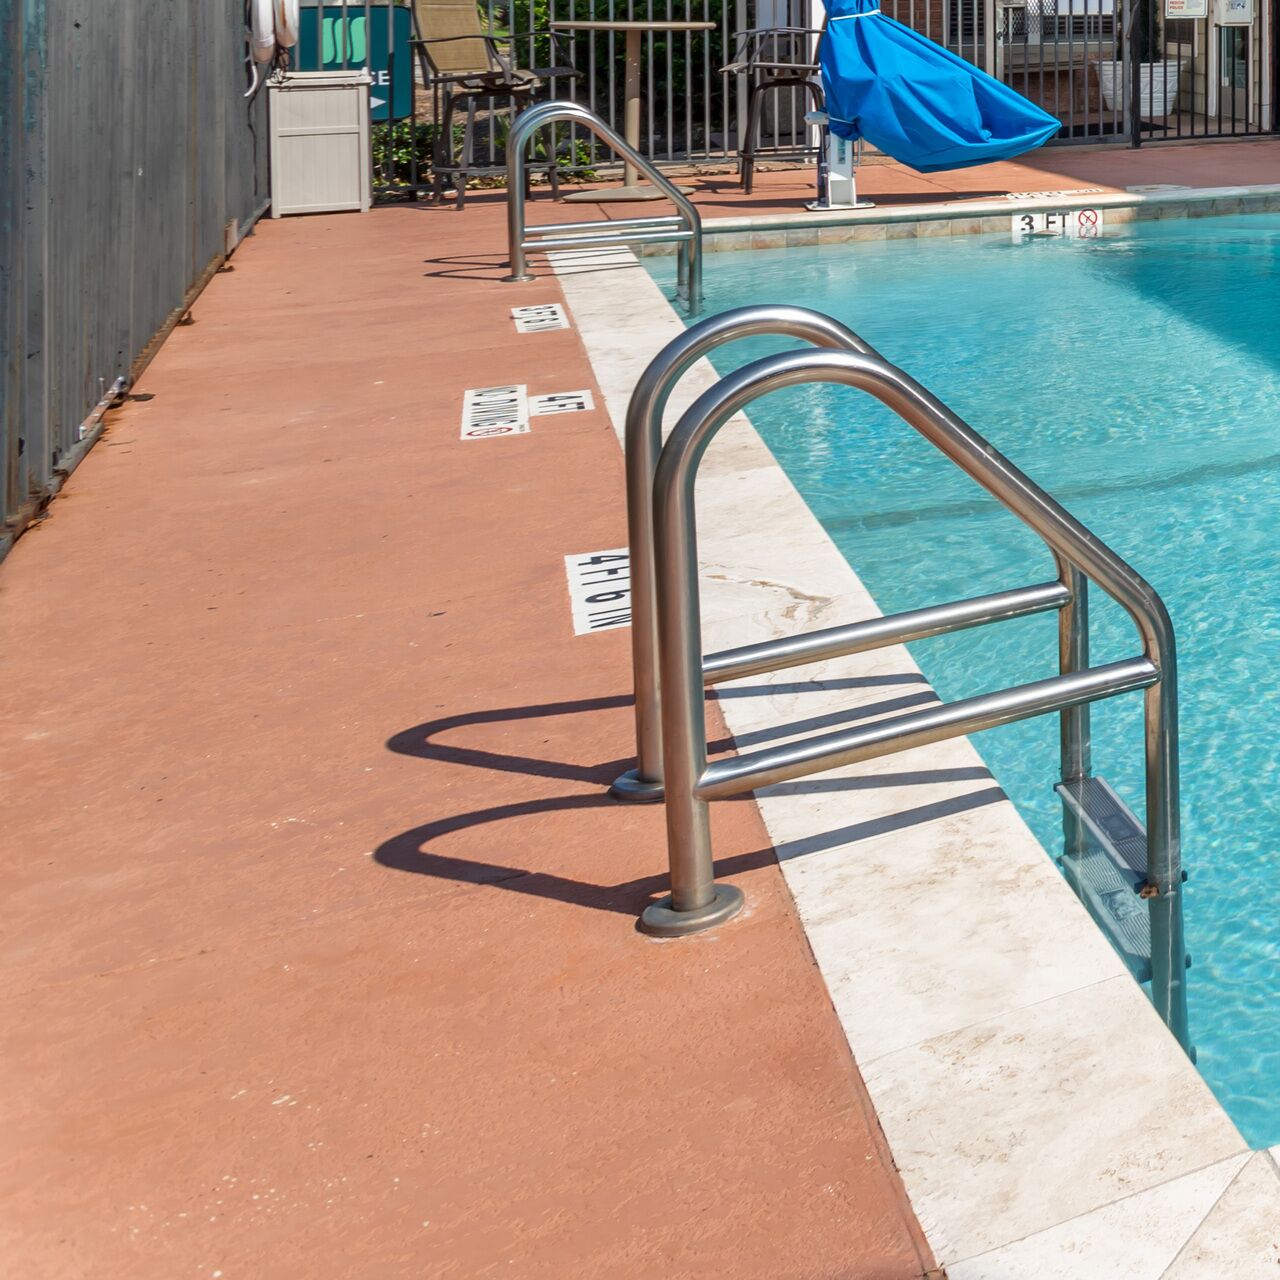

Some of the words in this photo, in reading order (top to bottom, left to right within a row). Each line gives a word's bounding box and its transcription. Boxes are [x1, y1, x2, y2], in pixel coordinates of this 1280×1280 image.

[1020, 214, 1035, 231] 3
[1046, 211, 1070, 229] FT
[538, 395, 582, 403] 4
[538, 402, 585, 413] FT
[577, 554, 631, 567] 4
[585, 589, 631, 603] 6
